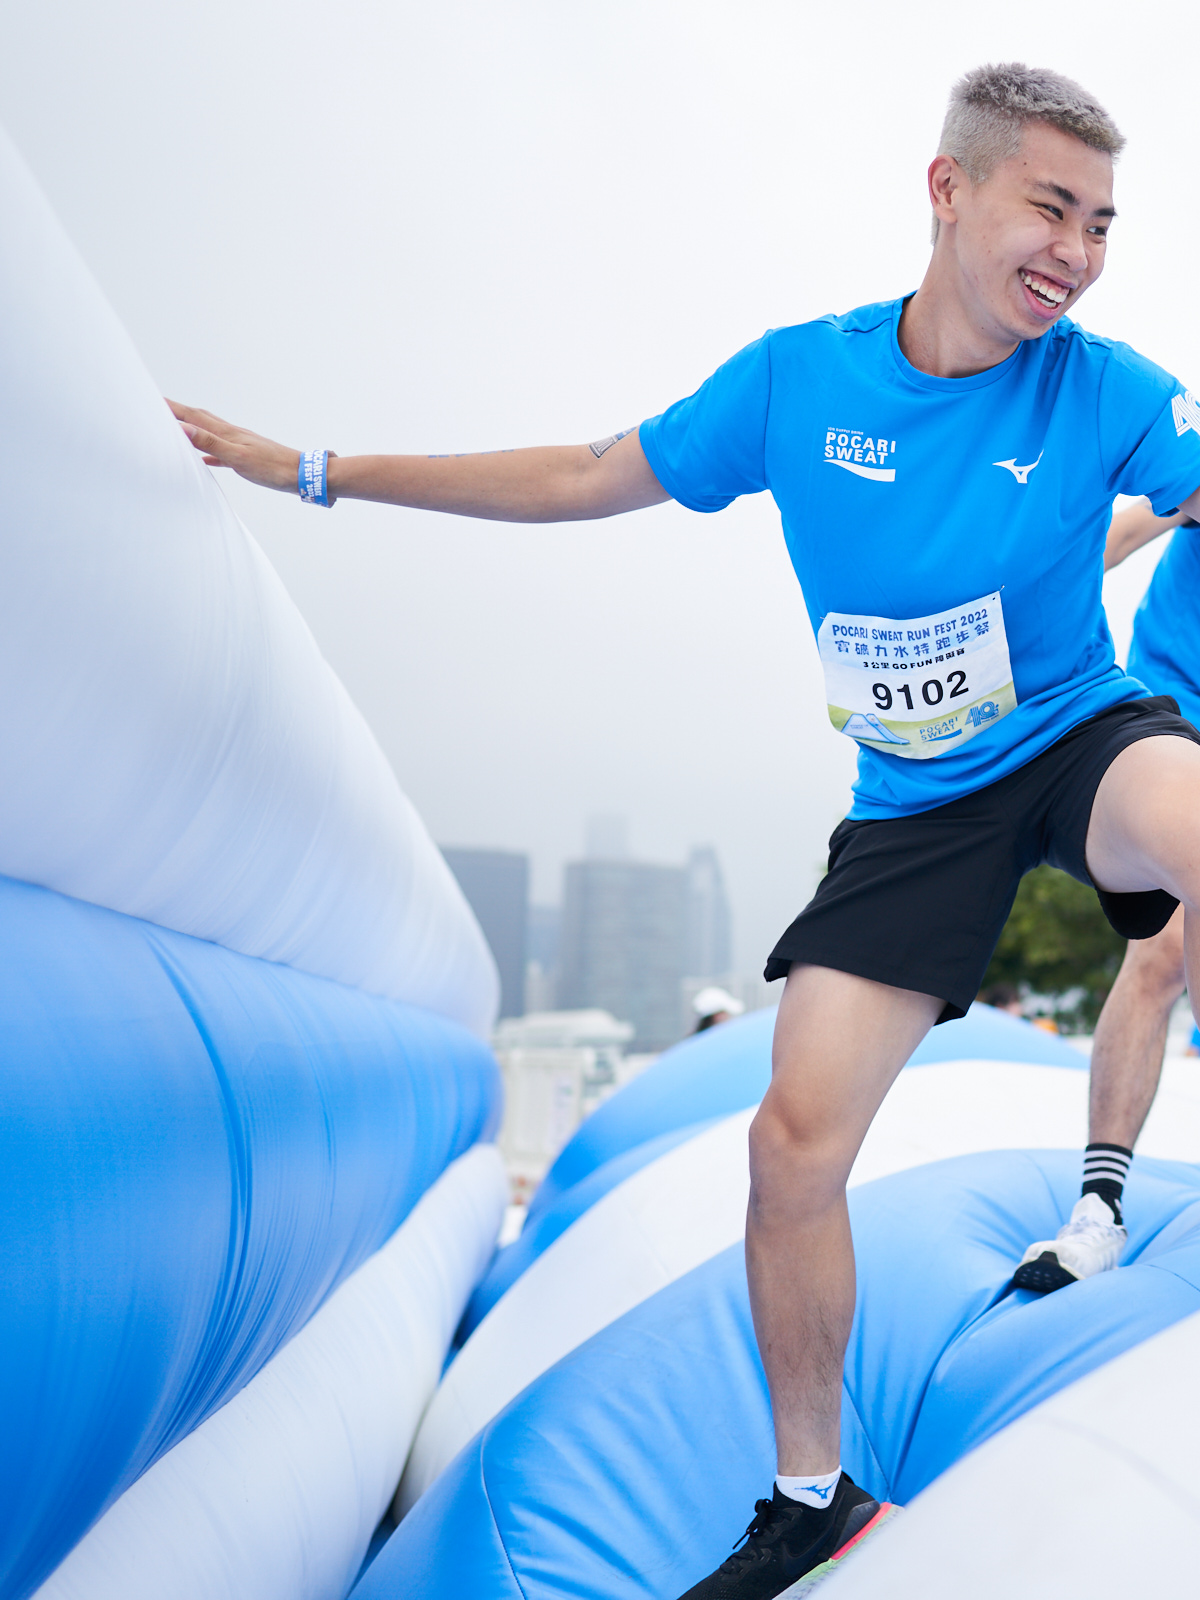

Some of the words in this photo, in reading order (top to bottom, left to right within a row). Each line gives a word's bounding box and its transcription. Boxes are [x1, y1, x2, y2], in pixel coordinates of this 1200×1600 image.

[826, 432, 896, 453] POCARI
[313, 450, 324, 475] OCARI
[824, 445, 888, 464] SWEAT
[832, 624, 868, 639] POCARI
[872, 628, 903, 642] SWEAT
[908, 627, 931, 642] RUN
[935, 620, 957, 636] FEST
[960, 608, 989, 627] 2022
[892, 662, 908, 670] GO
[910, 658, 934, 669] FUN
[872, 670, 970, 710] 9102
[919, 716, 959, 735] POCARI
[921, 723, 956, 742] SWEAT
